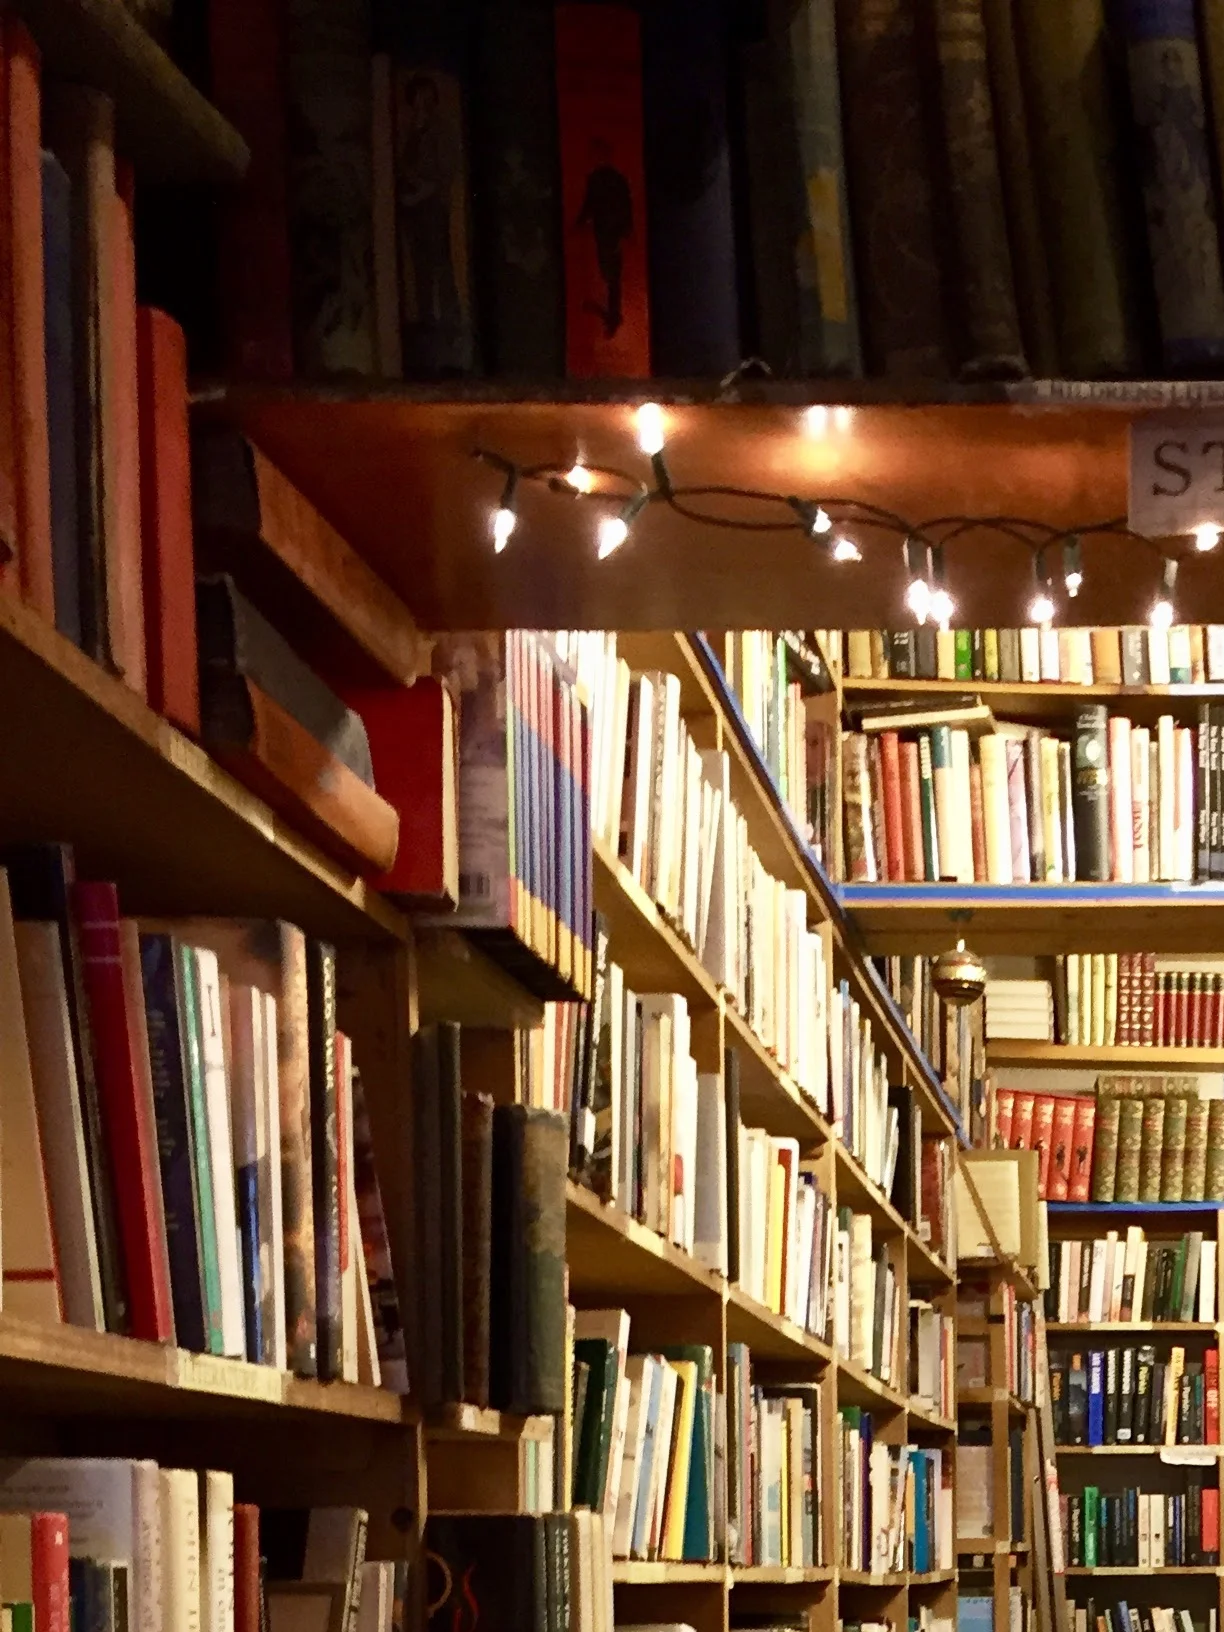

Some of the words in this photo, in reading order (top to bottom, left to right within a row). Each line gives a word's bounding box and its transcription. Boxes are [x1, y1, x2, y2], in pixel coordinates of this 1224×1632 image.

[142, 1521, 154, 1597] avenue
[186, 1499, 199, 1592] JOHN
[217, 1568, 228, 1592] in
[143, 1605, 154, 1629] of
